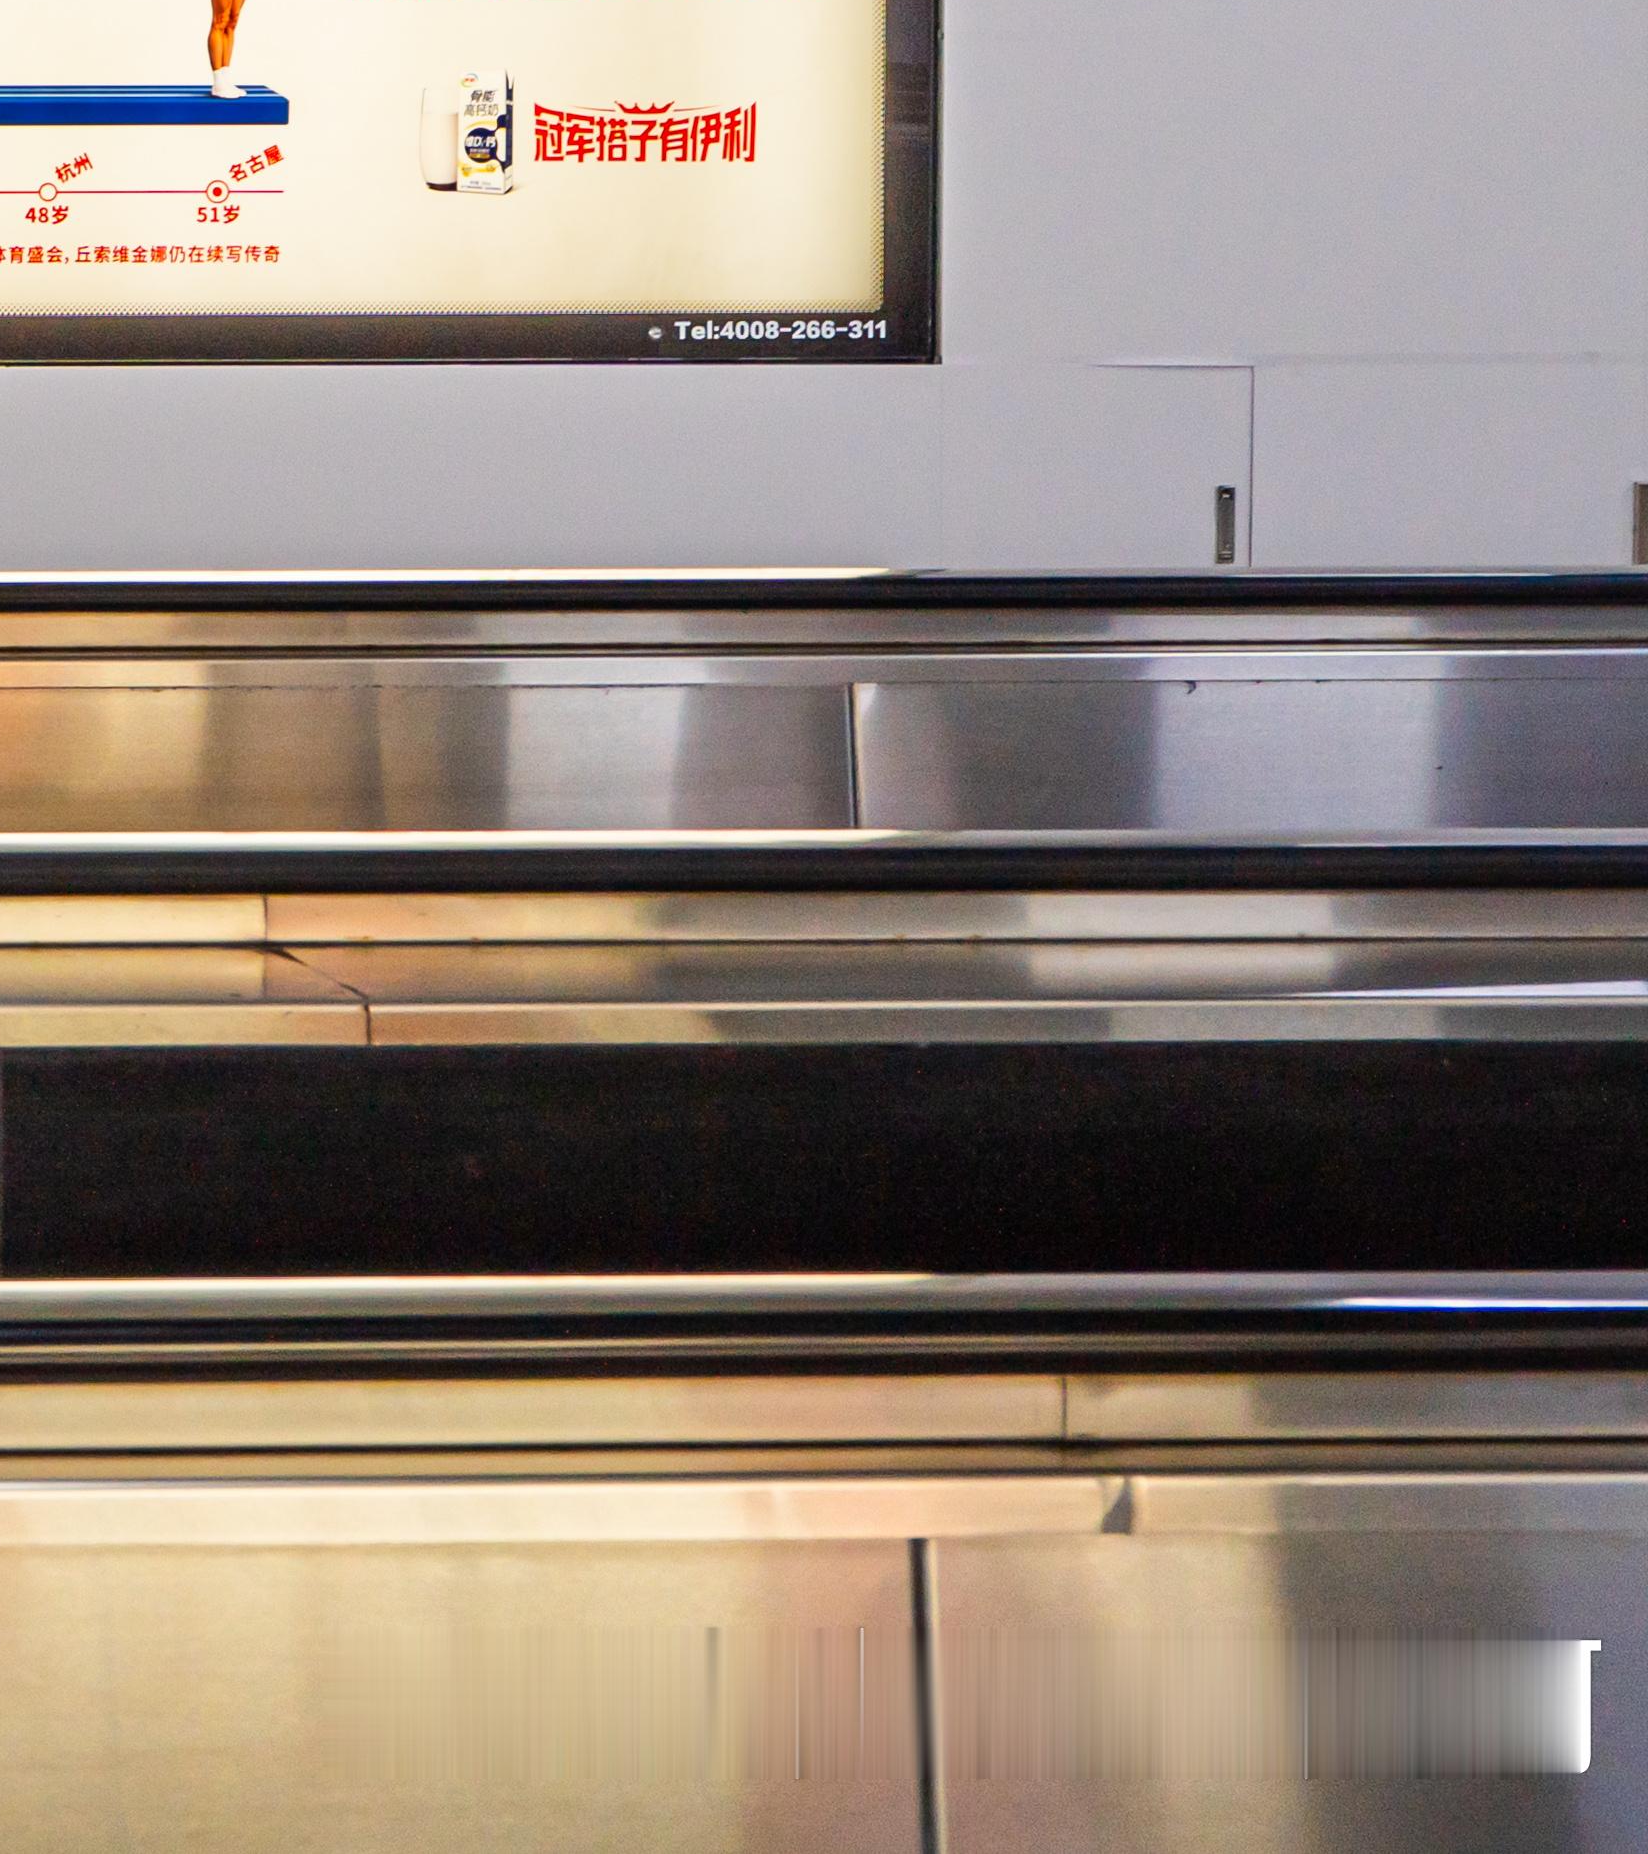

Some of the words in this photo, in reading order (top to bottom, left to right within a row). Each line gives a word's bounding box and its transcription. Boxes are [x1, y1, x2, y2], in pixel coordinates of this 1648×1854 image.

[533, 102, 758, 164] 冠军搭子有伊利
[55, 153, 94, 185] 杭州
[229, 144, 285, 185] 名古屋
[25, 205, 70, 225] 48岁
[197, 205, 241, 225] 51岁
[673, 319, 888, 341] Tel:4008-266-311
